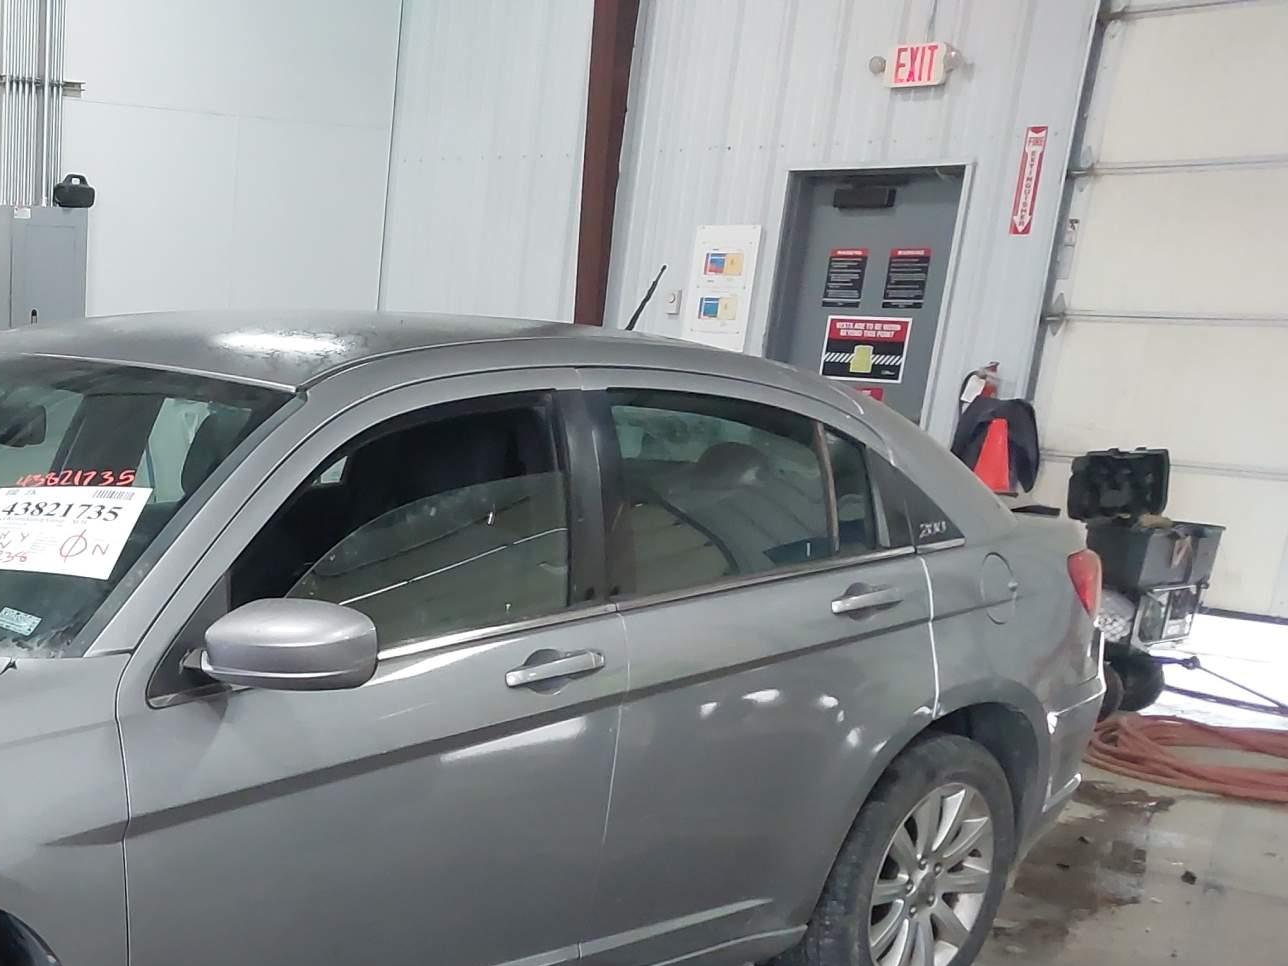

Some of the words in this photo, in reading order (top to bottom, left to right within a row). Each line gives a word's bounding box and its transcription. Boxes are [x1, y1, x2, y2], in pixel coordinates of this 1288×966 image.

[893, 45, 939, 83] EXIT
[15, 469, 137, 487] 43821735
[1, 500, 123, 522] 43821735
